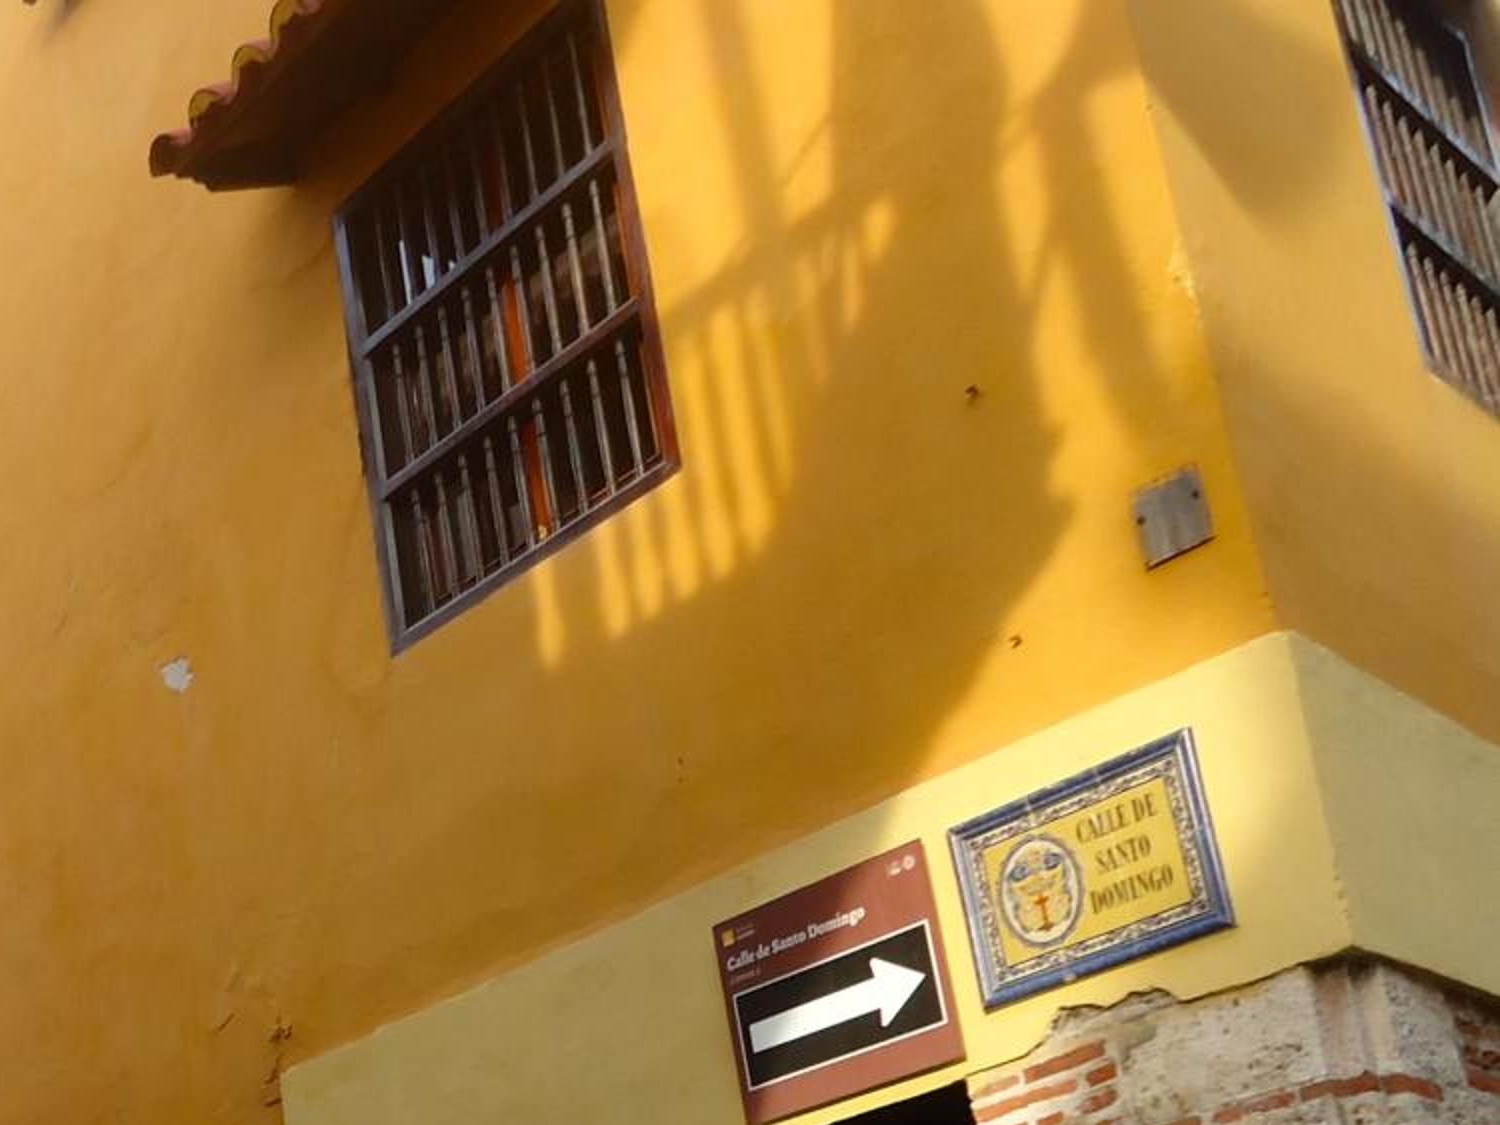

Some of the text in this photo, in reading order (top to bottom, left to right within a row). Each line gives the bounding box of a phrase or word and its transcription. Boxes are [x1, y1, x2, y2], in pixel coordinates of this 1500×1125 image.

[1076, 793, 1157, 843] CALLE DE
[1095, 834, 1152, 875] SANTO
[1090, 864, 1173, 914] DOMINGO
[727, 951, 755, 971] Calle
[756, 943, 771, 959] de
[771, 931, 806, 953] Santo
[807, 906, 865, 938] Domingo
